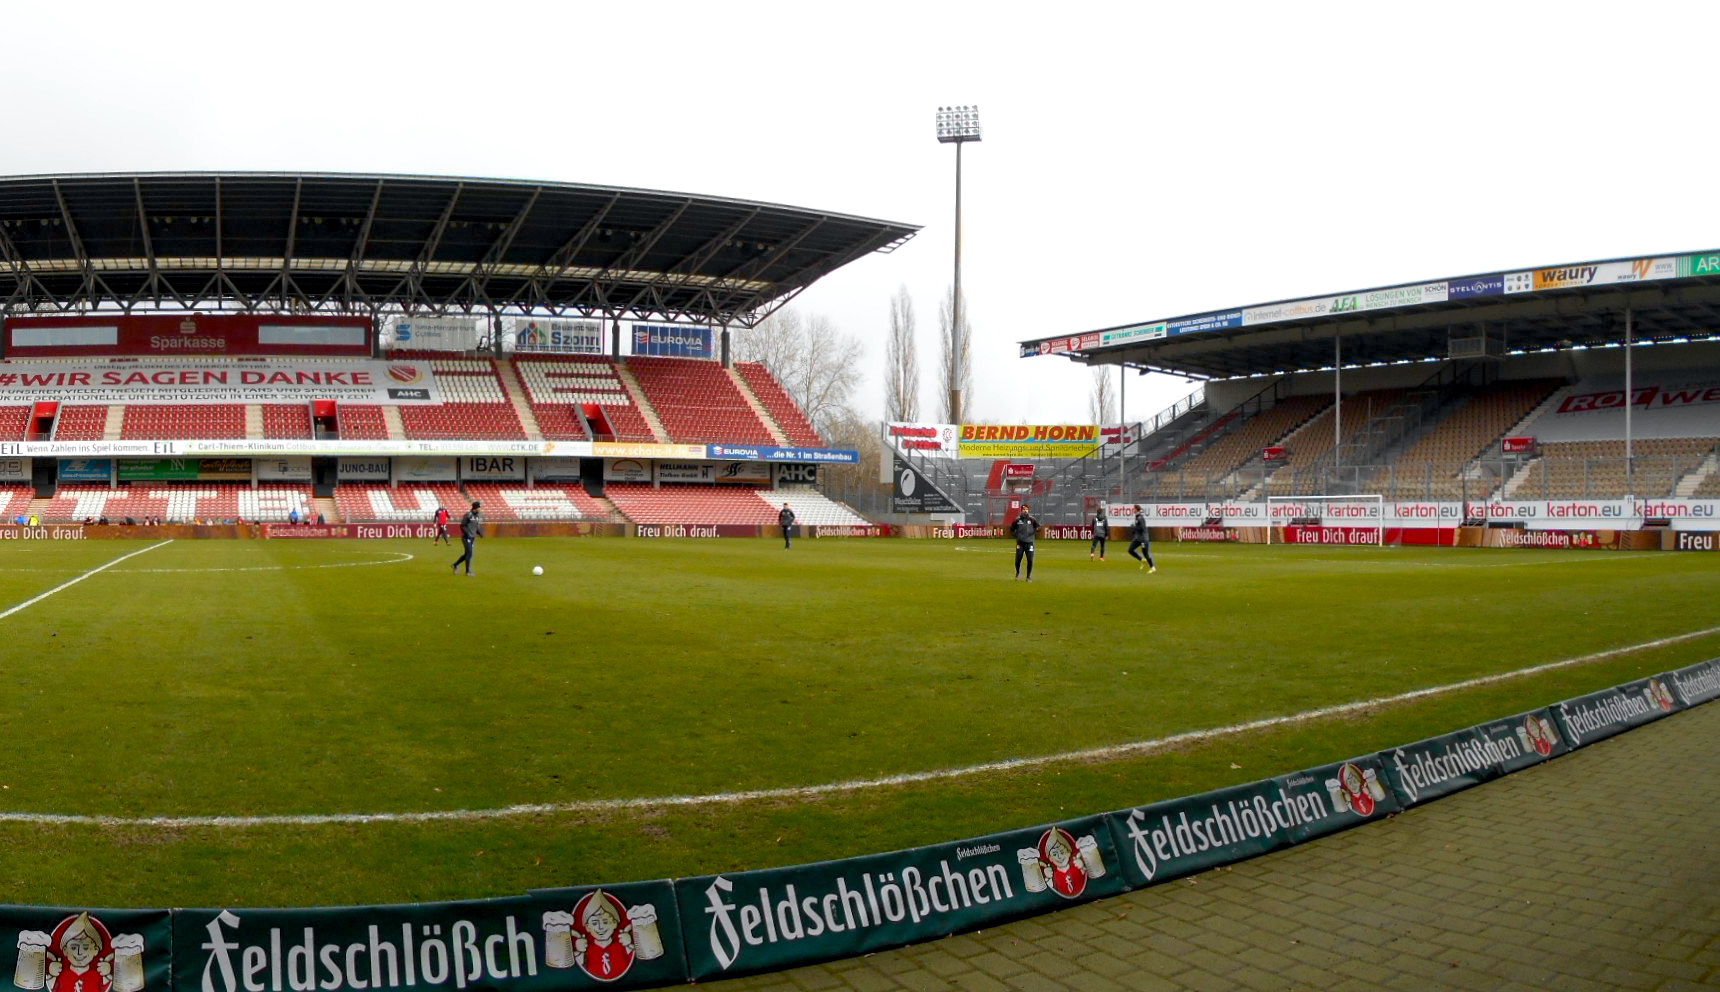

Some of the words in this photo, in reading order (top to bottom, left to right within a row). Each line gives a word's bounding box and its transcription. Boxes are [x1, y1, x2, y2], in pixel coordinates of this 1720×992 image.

[1542, 266, 1597, 283] waury
[1424, 284, 1446, 293] SCHÖN
[1450, 282, 1502, 293] STELLANTIS
[1365, 291, 1404, 302] LÖSUNGEN
[1406, 288, 1422, 297] VON
[1253, 304, 1326, 320] internet-cottbus.de
[551, 322, 599, 332] Bauzentrum
[150, 336, 226, 351] Sparkasse
[651, 335, 702, 346] EUROVIA
[101, 371, 227, 385] SAGEN
[241, 371, 373, 385] DANKE
[29, 393, 125, 401] SENSATIONELLE
[397, 390, 422, 398] AHC
[962, 425, 1029, 442] BERND
[1034, 425, 1096, 442] HORN
[1, 443, 23, 454] ETL
[27, 445, 48, 453] Wenn
[50, 444, 76, 453] Zahlen
[92, 443, 111, 454] Spiel
[113, 444, 149, 452] kommen.
[154, 441, 176, 453] ETL
[198, 442, 284, 450] Carl-Thiem-Klinikum
[286, 441, 316, 449] Cottbus
[959, 443, 992, 451] Moderne
[786, 451, 797, 459] Nr.
[814, 452, 852, 461] Straßenbau
[339, 463, 387, 473] JUNO-BAU
[470, 458, 514, 472] IBAR
[779, 465, 816, 481] AHC
[1156, 504, 1202, 517] karton.eu
[1208, 503, 1258, 517] karton.eu
[1394, 502, 1458, 518] karton.eu
[1467, 503, 1536, 518] karton.eu
[1547, 501, 1621, 518] karton.eu
[1633, 501, 1713, 518] karton.eu
[23, 526, 48, 539] Dich
[52, 526, 87, 539] drauf.
[357, 525, 382, 538] Freu
[387, 525, 412, 538] Dich
[638, 525, 661, 537] Freu
[664, 525, 686, 537] Dich
[690, 525, 720, 537] drauf.
[816, 525, 865, 538] Feldschlößchen
[933, 527, 954, 539] Freu
[1044, 527, 1060, 539] Freu
[1062, 527, 1078, 539] Dich
[1179, 526, 1225, 541] Feldschlößchen
[1297, 528, 1318, 543] Freu
[1323, 527, 1345, 543] Dich
[1499, 529, 1569, 547] Feldschlößchen
[1680, 532, 1713, 549] Freu
[1560, 685, 1649, 745] Feldschlößchen
[1393, 728, 1521, 802] Feldschlößchen
[1126, 783, 1328, 881] Feldschlößchen
[704, 859, 1013, 970] Feldschlößchen
